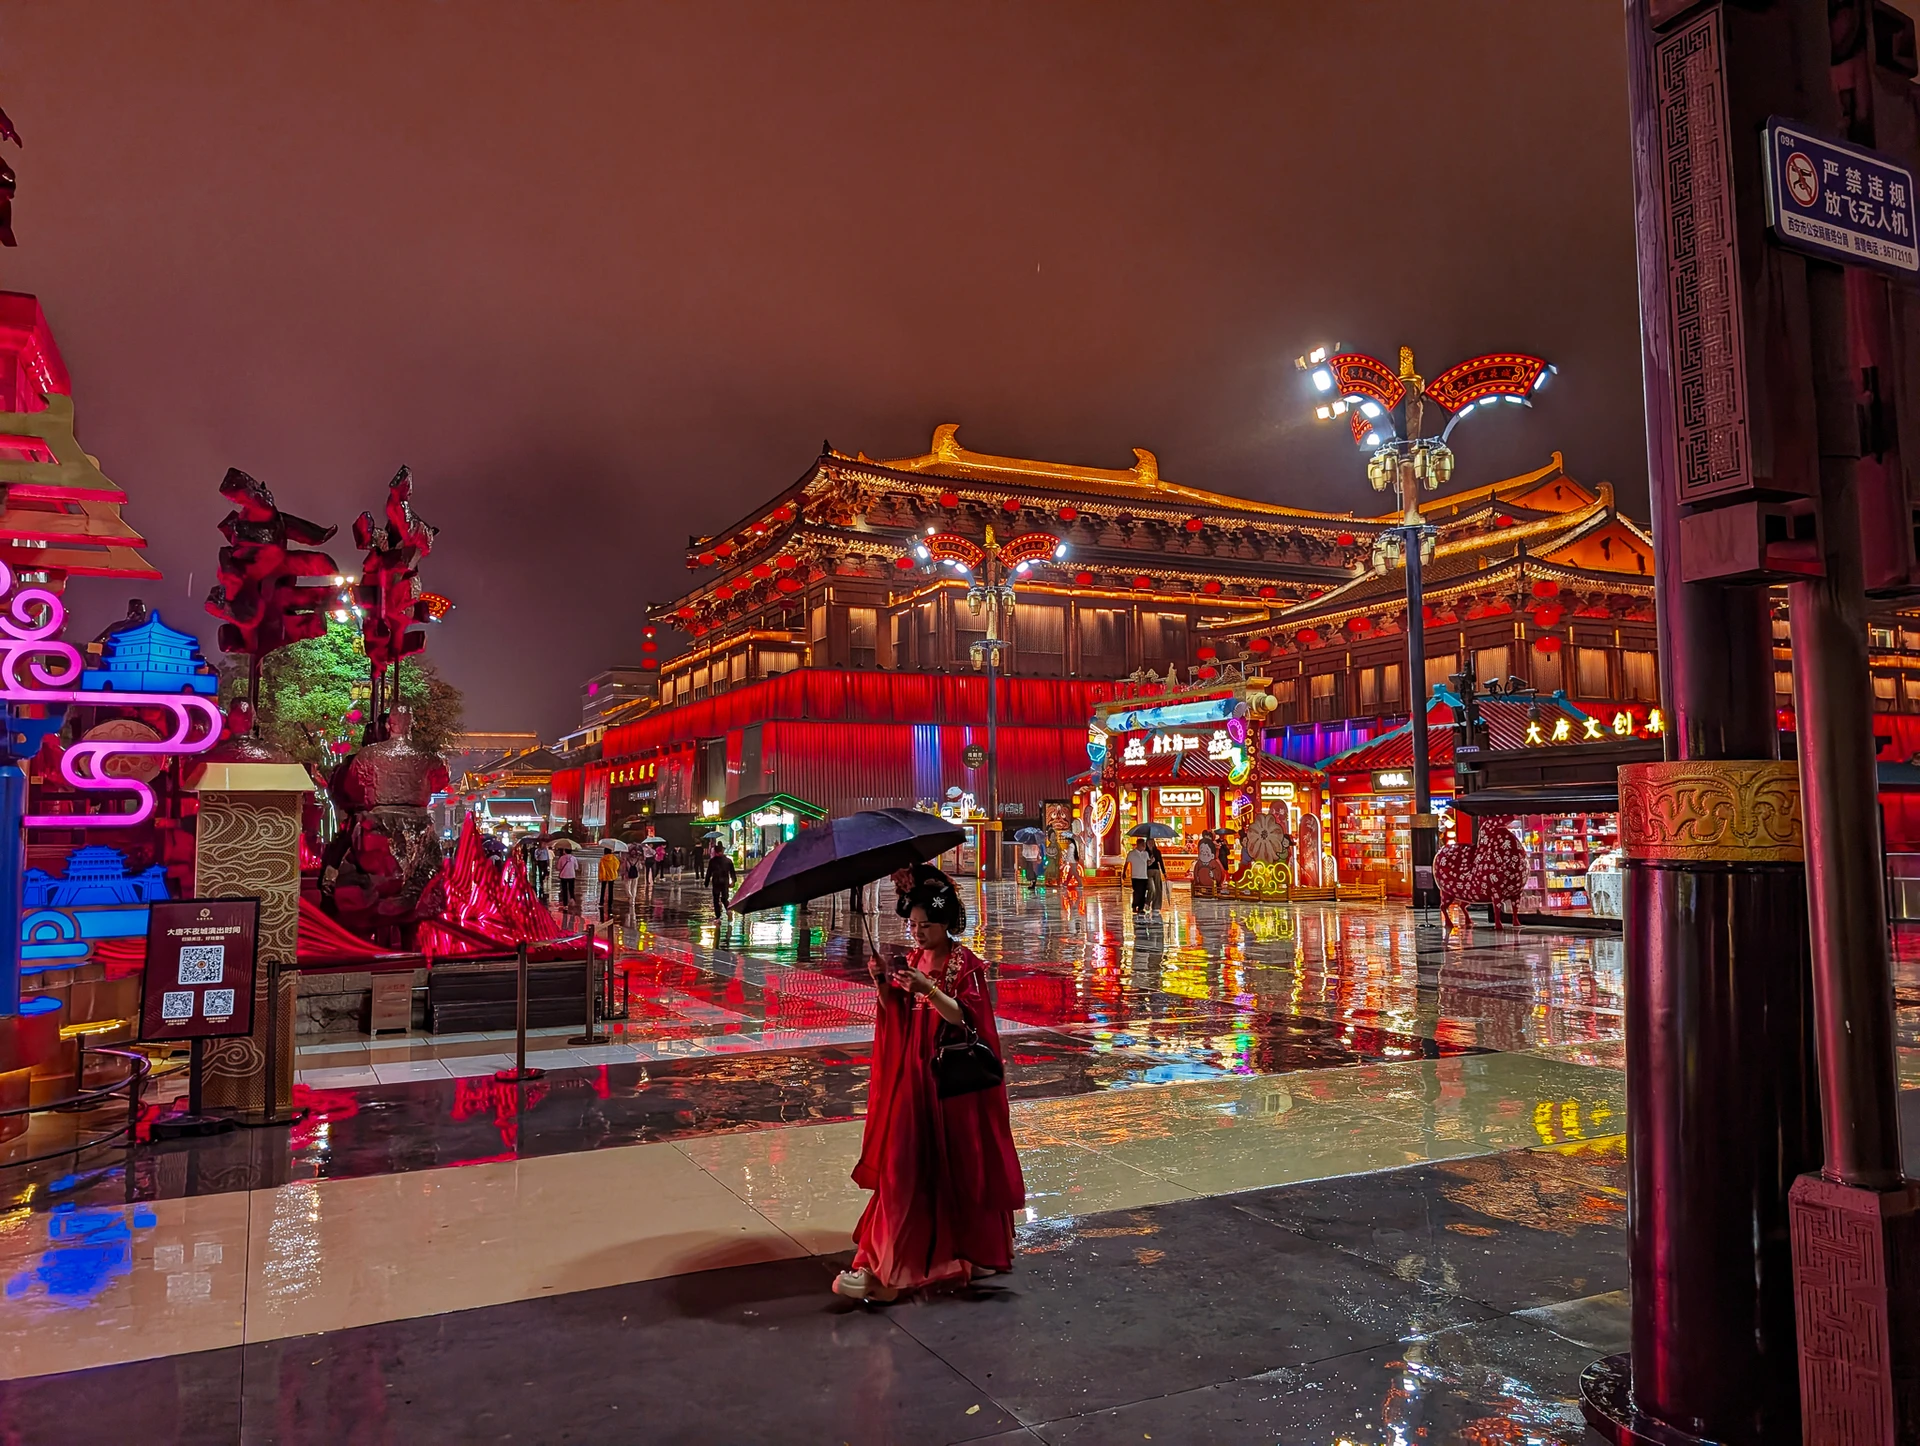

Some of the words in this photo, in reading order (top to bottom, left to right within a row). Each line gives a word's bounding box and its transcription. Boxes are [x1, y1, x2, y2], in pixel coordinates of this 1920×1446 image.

[1780, 134, 1795, 148] 094
[1822, 158, 1907, 209] 严禁违规
[1823, 189, 1909, 238] 放飞无人机
[166, 926, 241, 936] 大唐不夜城演出时间
